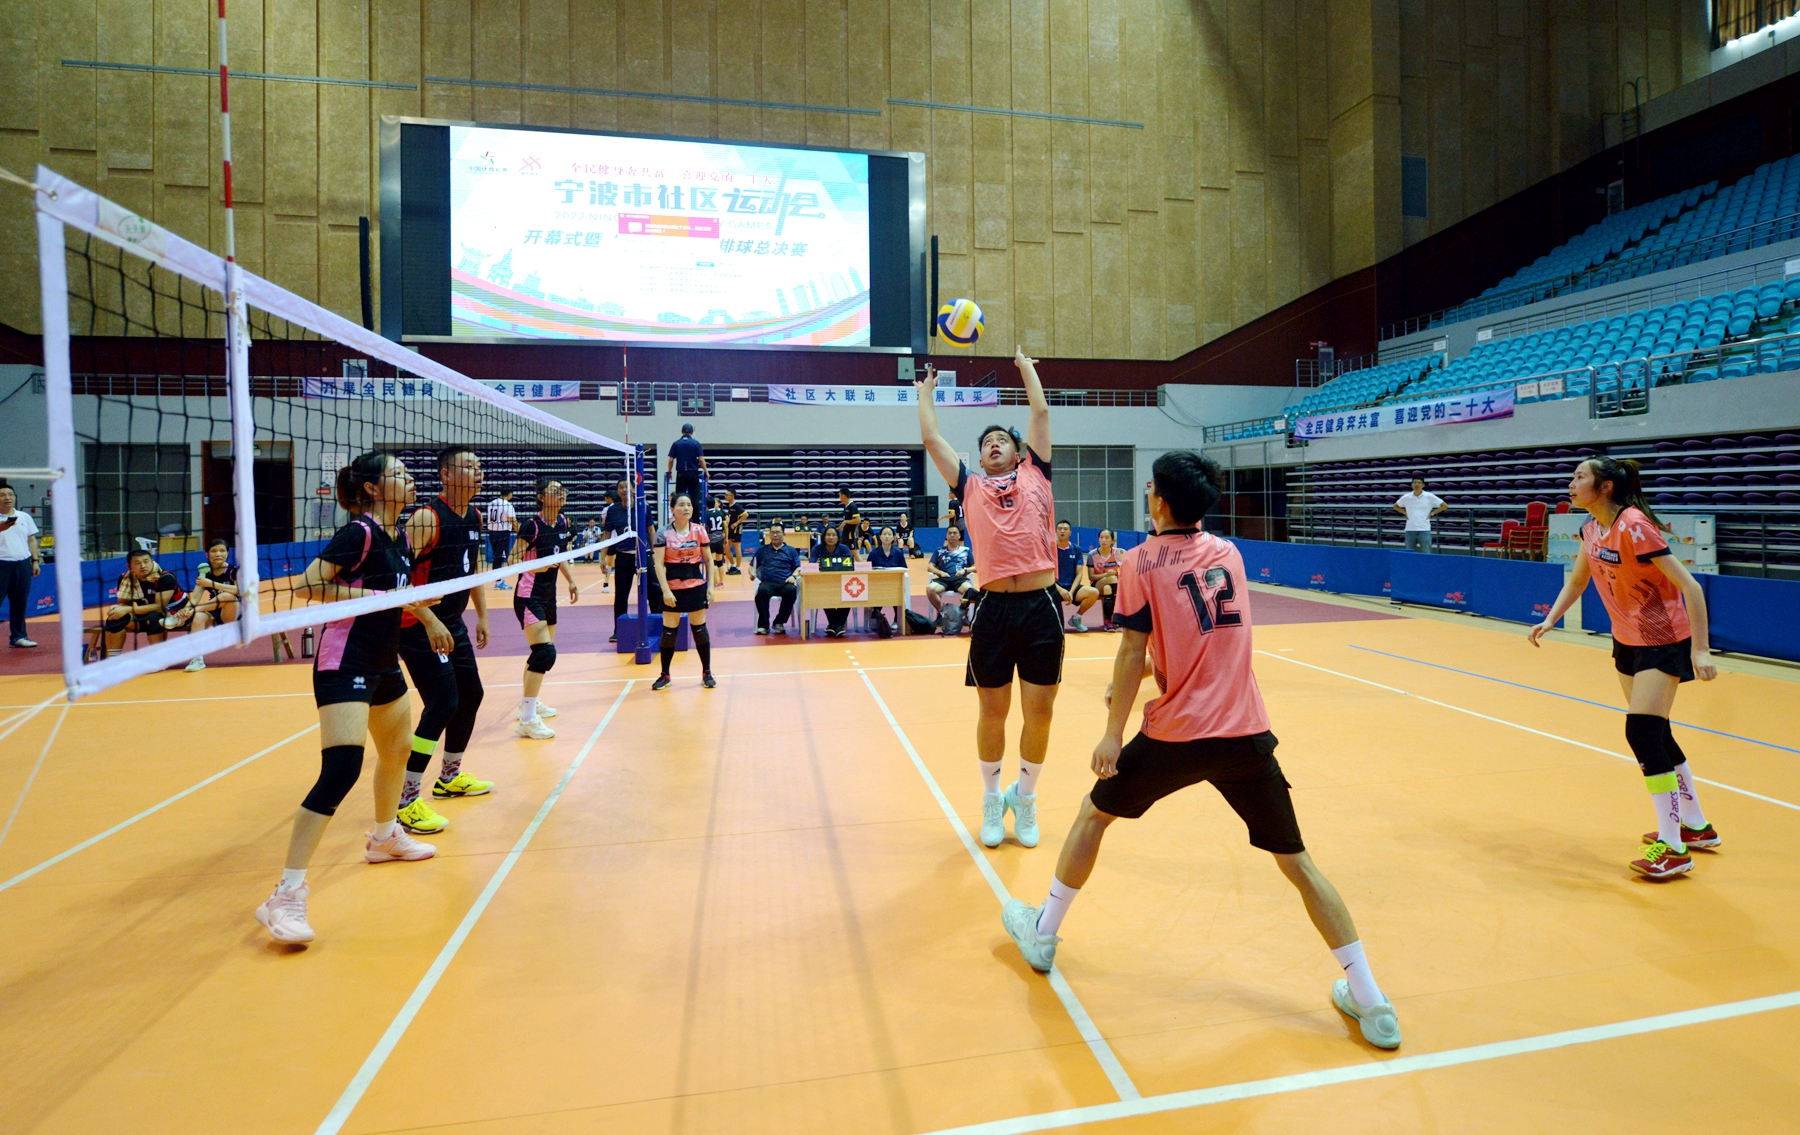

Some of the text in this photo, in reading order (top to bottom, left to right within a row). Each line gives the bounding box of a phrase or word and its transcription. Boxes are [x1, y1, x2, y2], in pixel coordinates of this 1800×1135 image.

[554, 175, 826, 233] 宁波市社区运动会
[554, 211, 585, 221] 2022
[728, 219, 773, 231] GAMES
[523, 228, 603, 248] 开幕式暨
[323, 381, 433, 396] 开展全民健身
[785, 387, 983, 403] 社区大联动 运展风采
[1304, 395, 1496, 435] 全民健身奔共富 喜迎党的二十大
[997, 493, 1014, 508] 15
[490, 508, 498, 522] 10
[709, 515, 723, 531] 12
[463, 548, 470, 573] 6
[1177, 564, 1243, 636] 12
